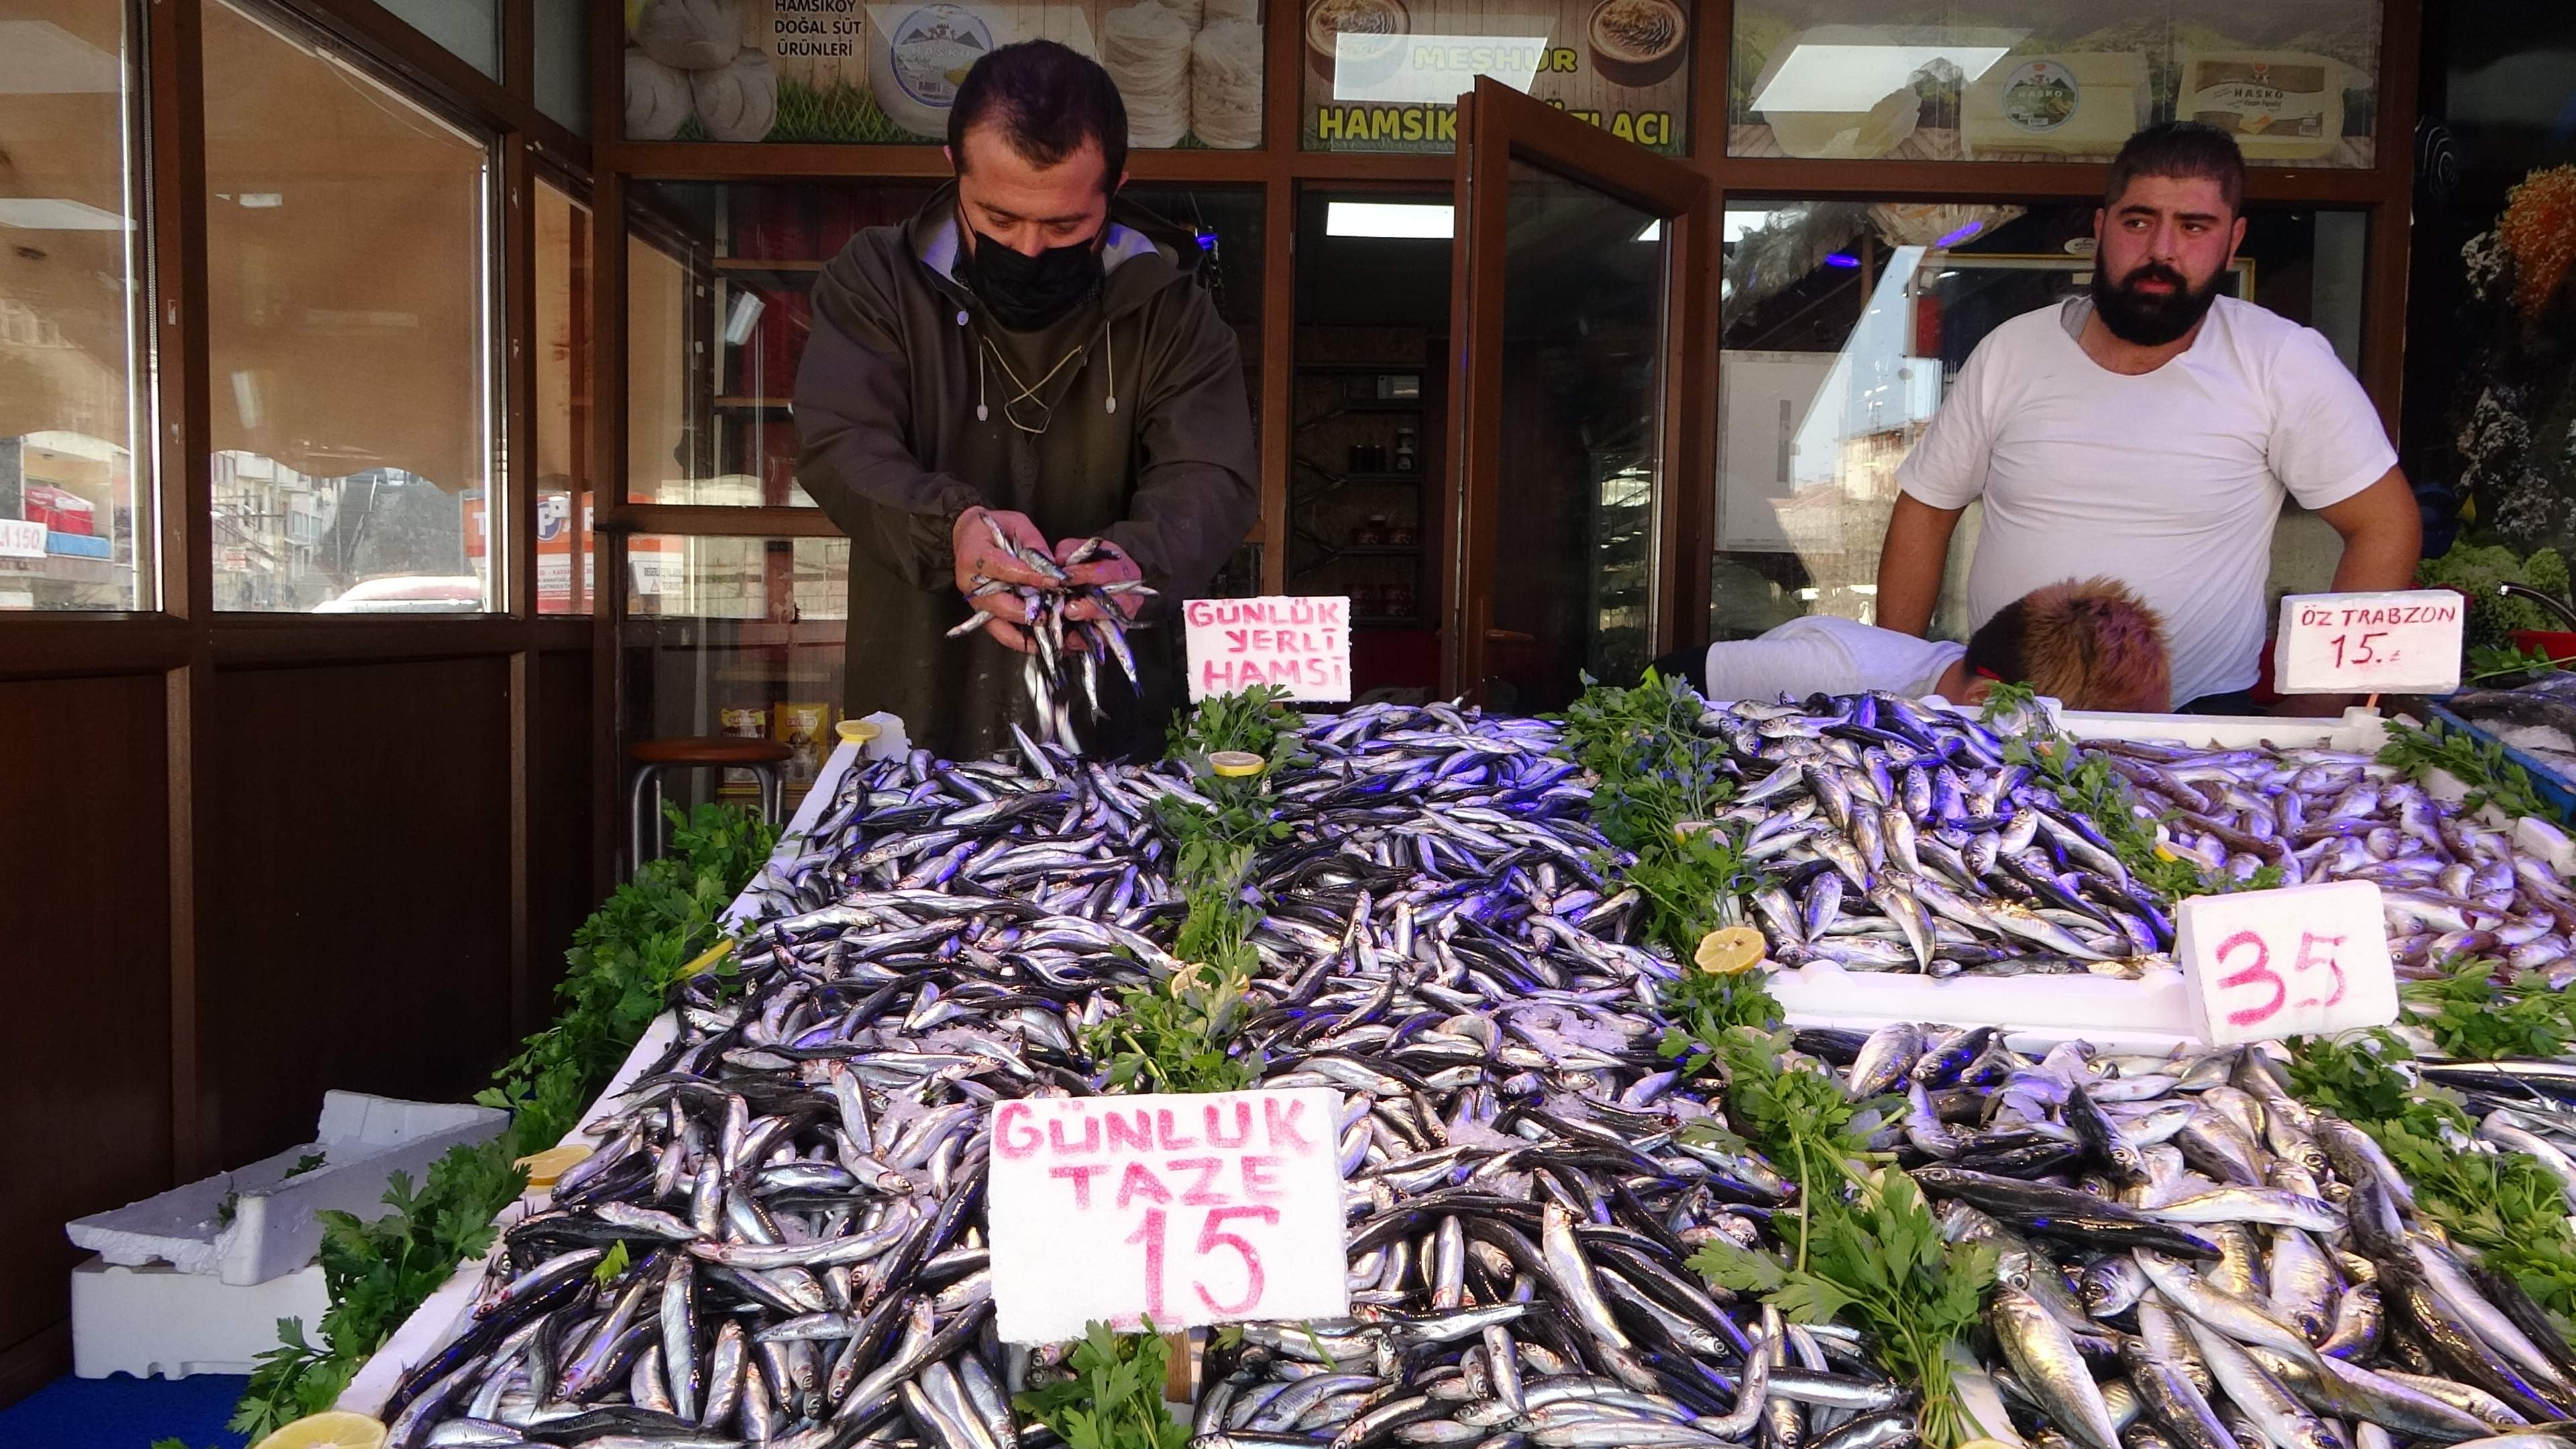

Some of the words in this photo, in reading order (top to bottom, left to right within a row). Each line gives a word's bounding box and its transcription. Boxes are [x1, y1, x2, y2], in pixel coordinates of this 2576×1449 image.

[775, 16, 827, 34] DOĞAL
[833, 17, 862, 34] SÜT
[777, 38, 853, 56] ÜRÜNLERİ
[1413, 46, 1578, 74] MEŞHUR
[2235, 88, 2284, 99] HASKO
[1187, 597, 1341, 627] GÜNLÜK
[2301, 605, 2332, 627] ÖZ
[2341, 606, 2456, 627] TRABZON
[2215, 930, 2349, 1028] 35
[994, 1095, 1316, 1159] GÜNLÜK
[1048, 1155, 1289, 1210] TAZE
[1110, 1205, 1280, 1328] 15
